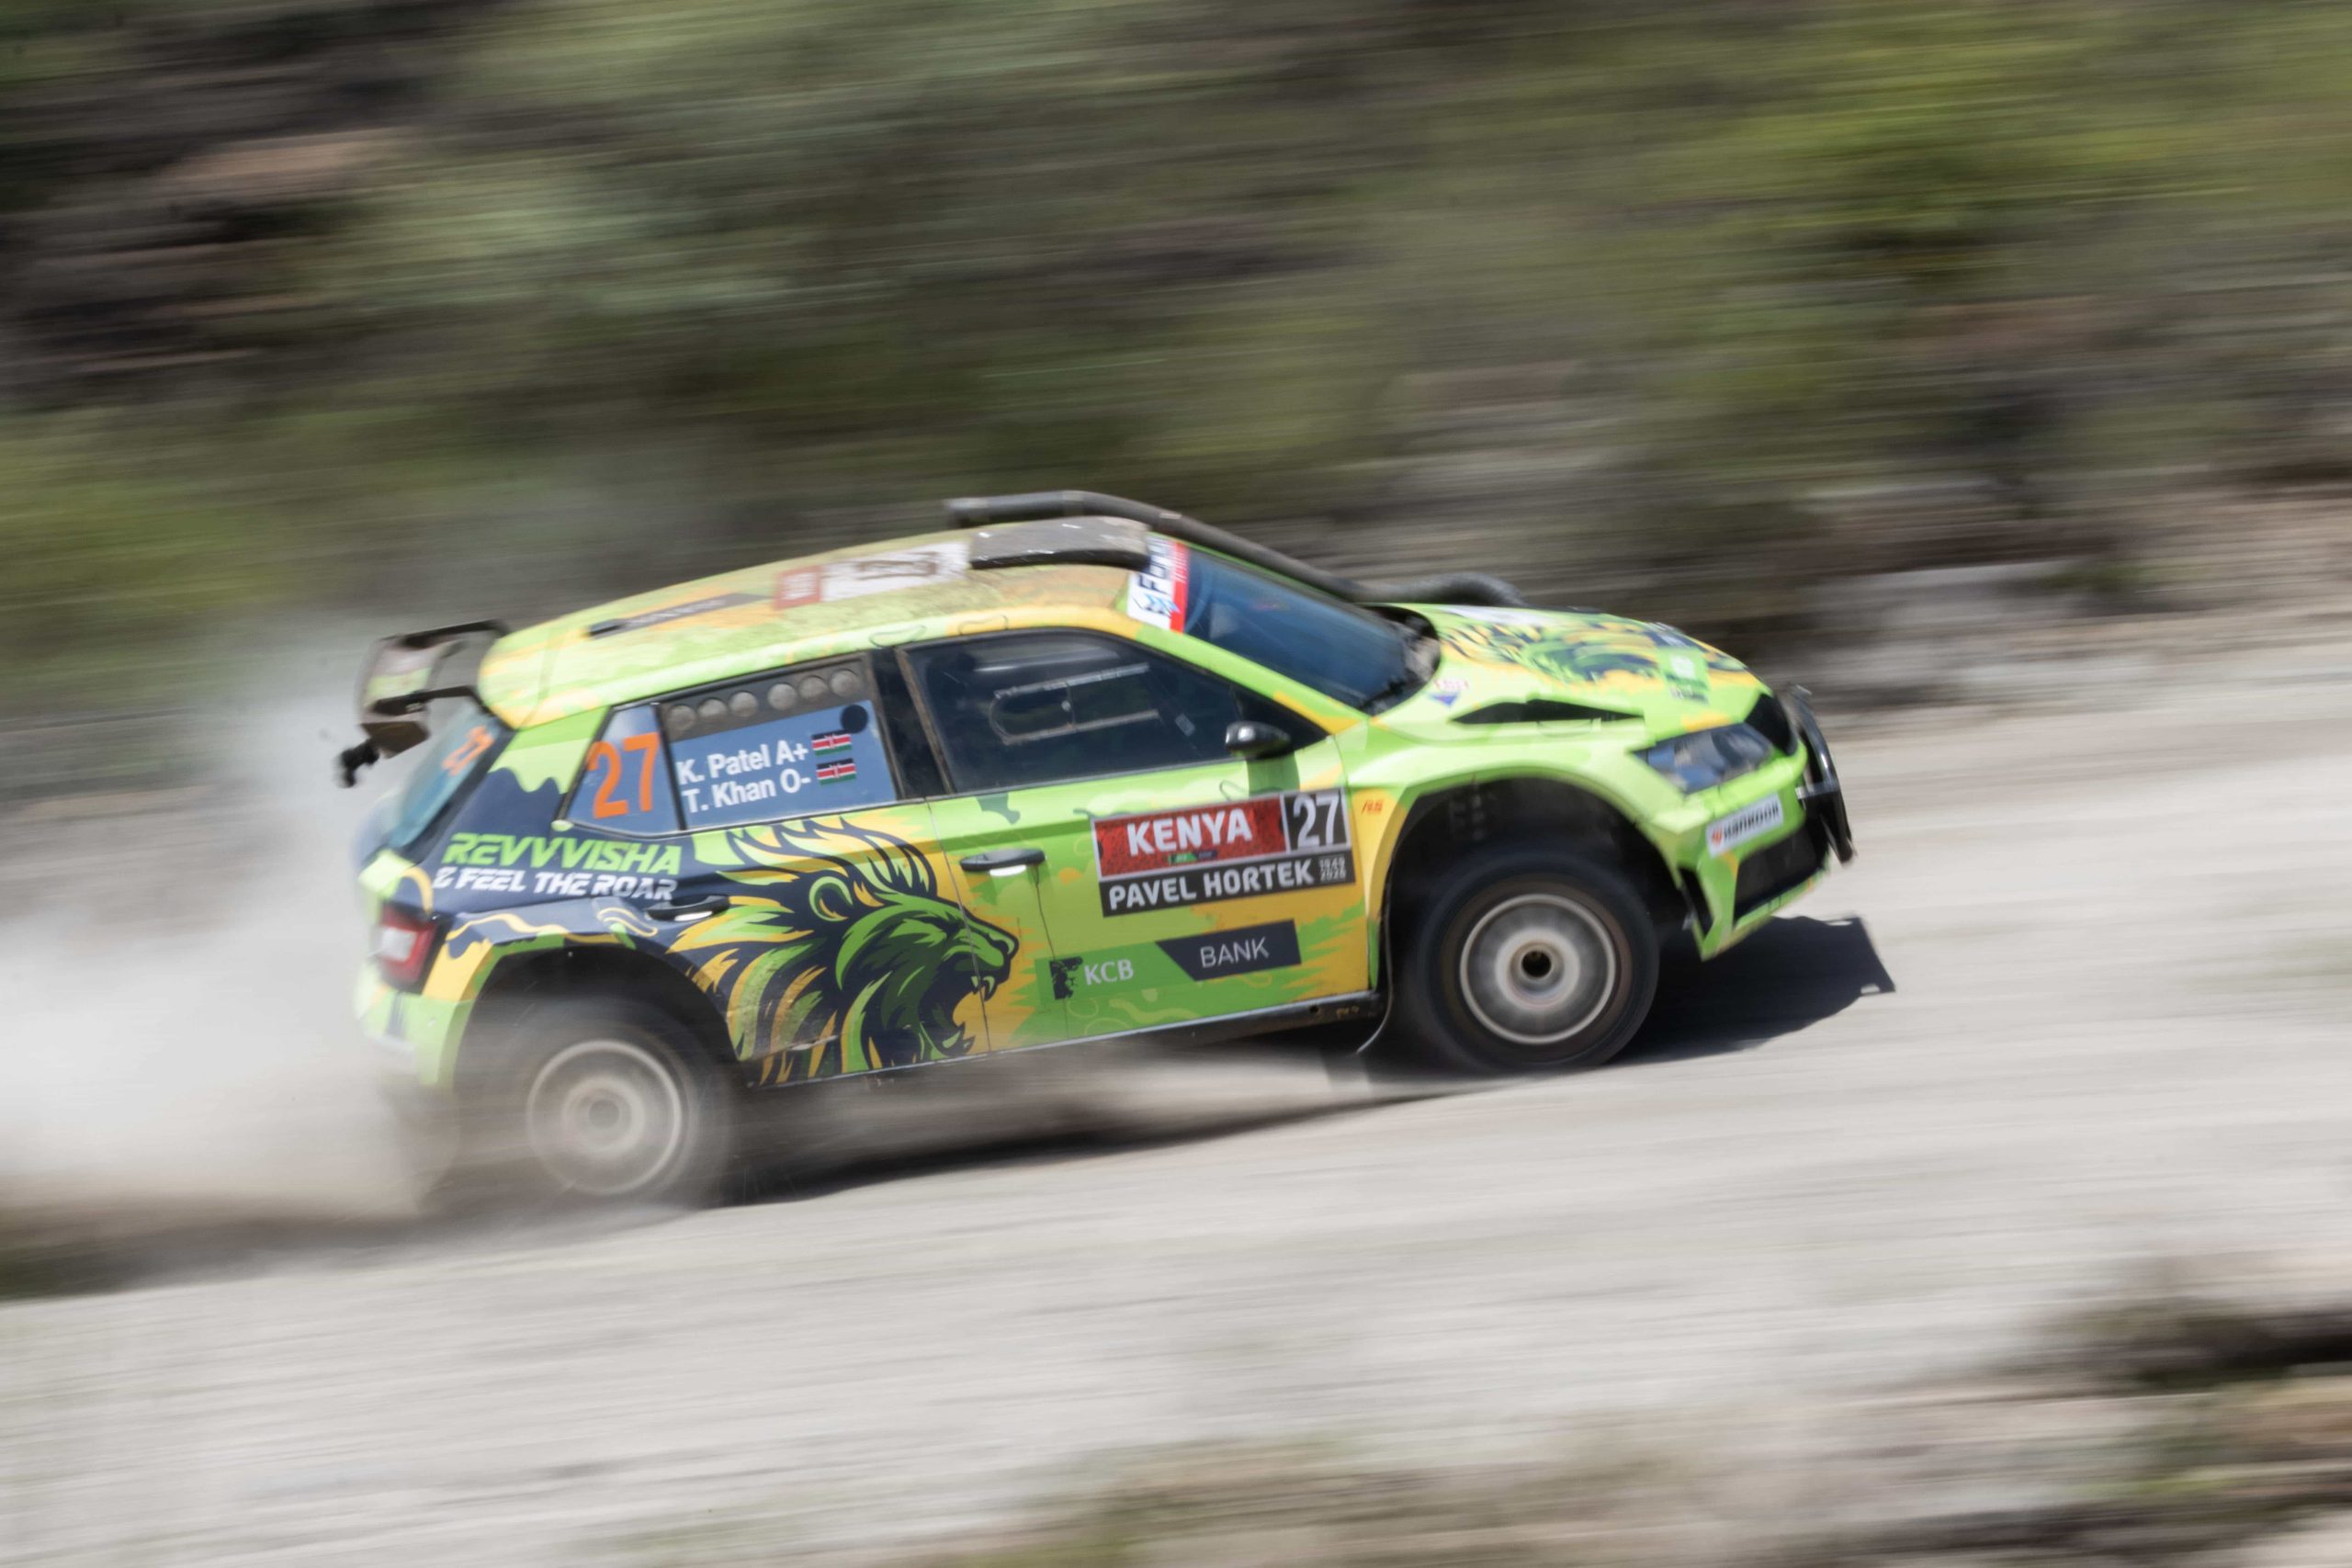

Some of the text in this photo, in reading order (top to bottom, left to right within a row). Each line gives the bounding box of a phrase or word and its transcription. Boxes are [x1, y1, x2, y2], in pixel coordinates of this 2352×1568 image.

[587, 731, 661, 818] 27
[677, 739, 808, 785] K. Patel A+
[682, 768, 812, 814] T. Khan O-
[1125, 793, 1340, 857] KENYA 27
[441, 831, 683, 875] REVVVISHA
[455, 867, 527, 894] FEEL
[533, 871, 593, 897] THE
[591, 874, 679, 902] ROAR
[1108, 859, 1316, 911] PAVEL HORTEK
[1082, 936, 1270, 986] KCB BANK
